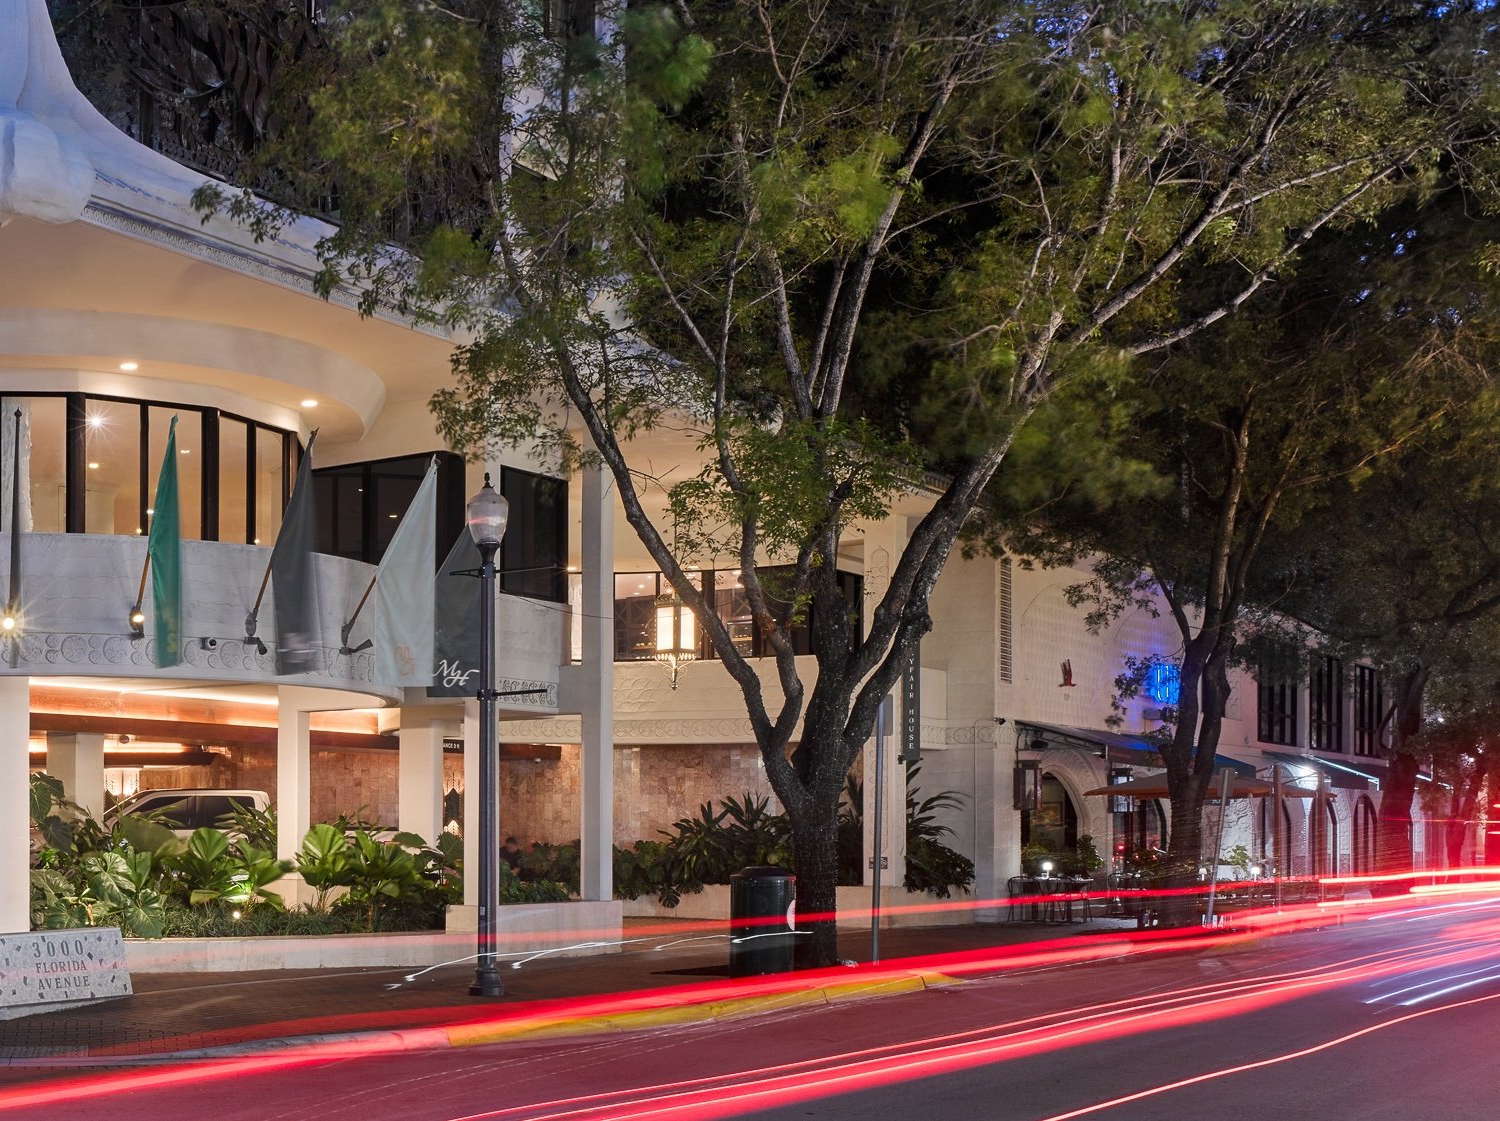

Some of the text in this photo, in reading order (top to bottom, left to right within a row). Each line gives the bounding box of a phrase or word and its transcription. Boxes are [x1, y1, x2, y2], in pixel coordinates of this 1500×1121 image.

[31, 940, 84, 959] 3000
[35, 960, 87, 974] FLORIDA
[38, 975, 90, 991] AVENUE
